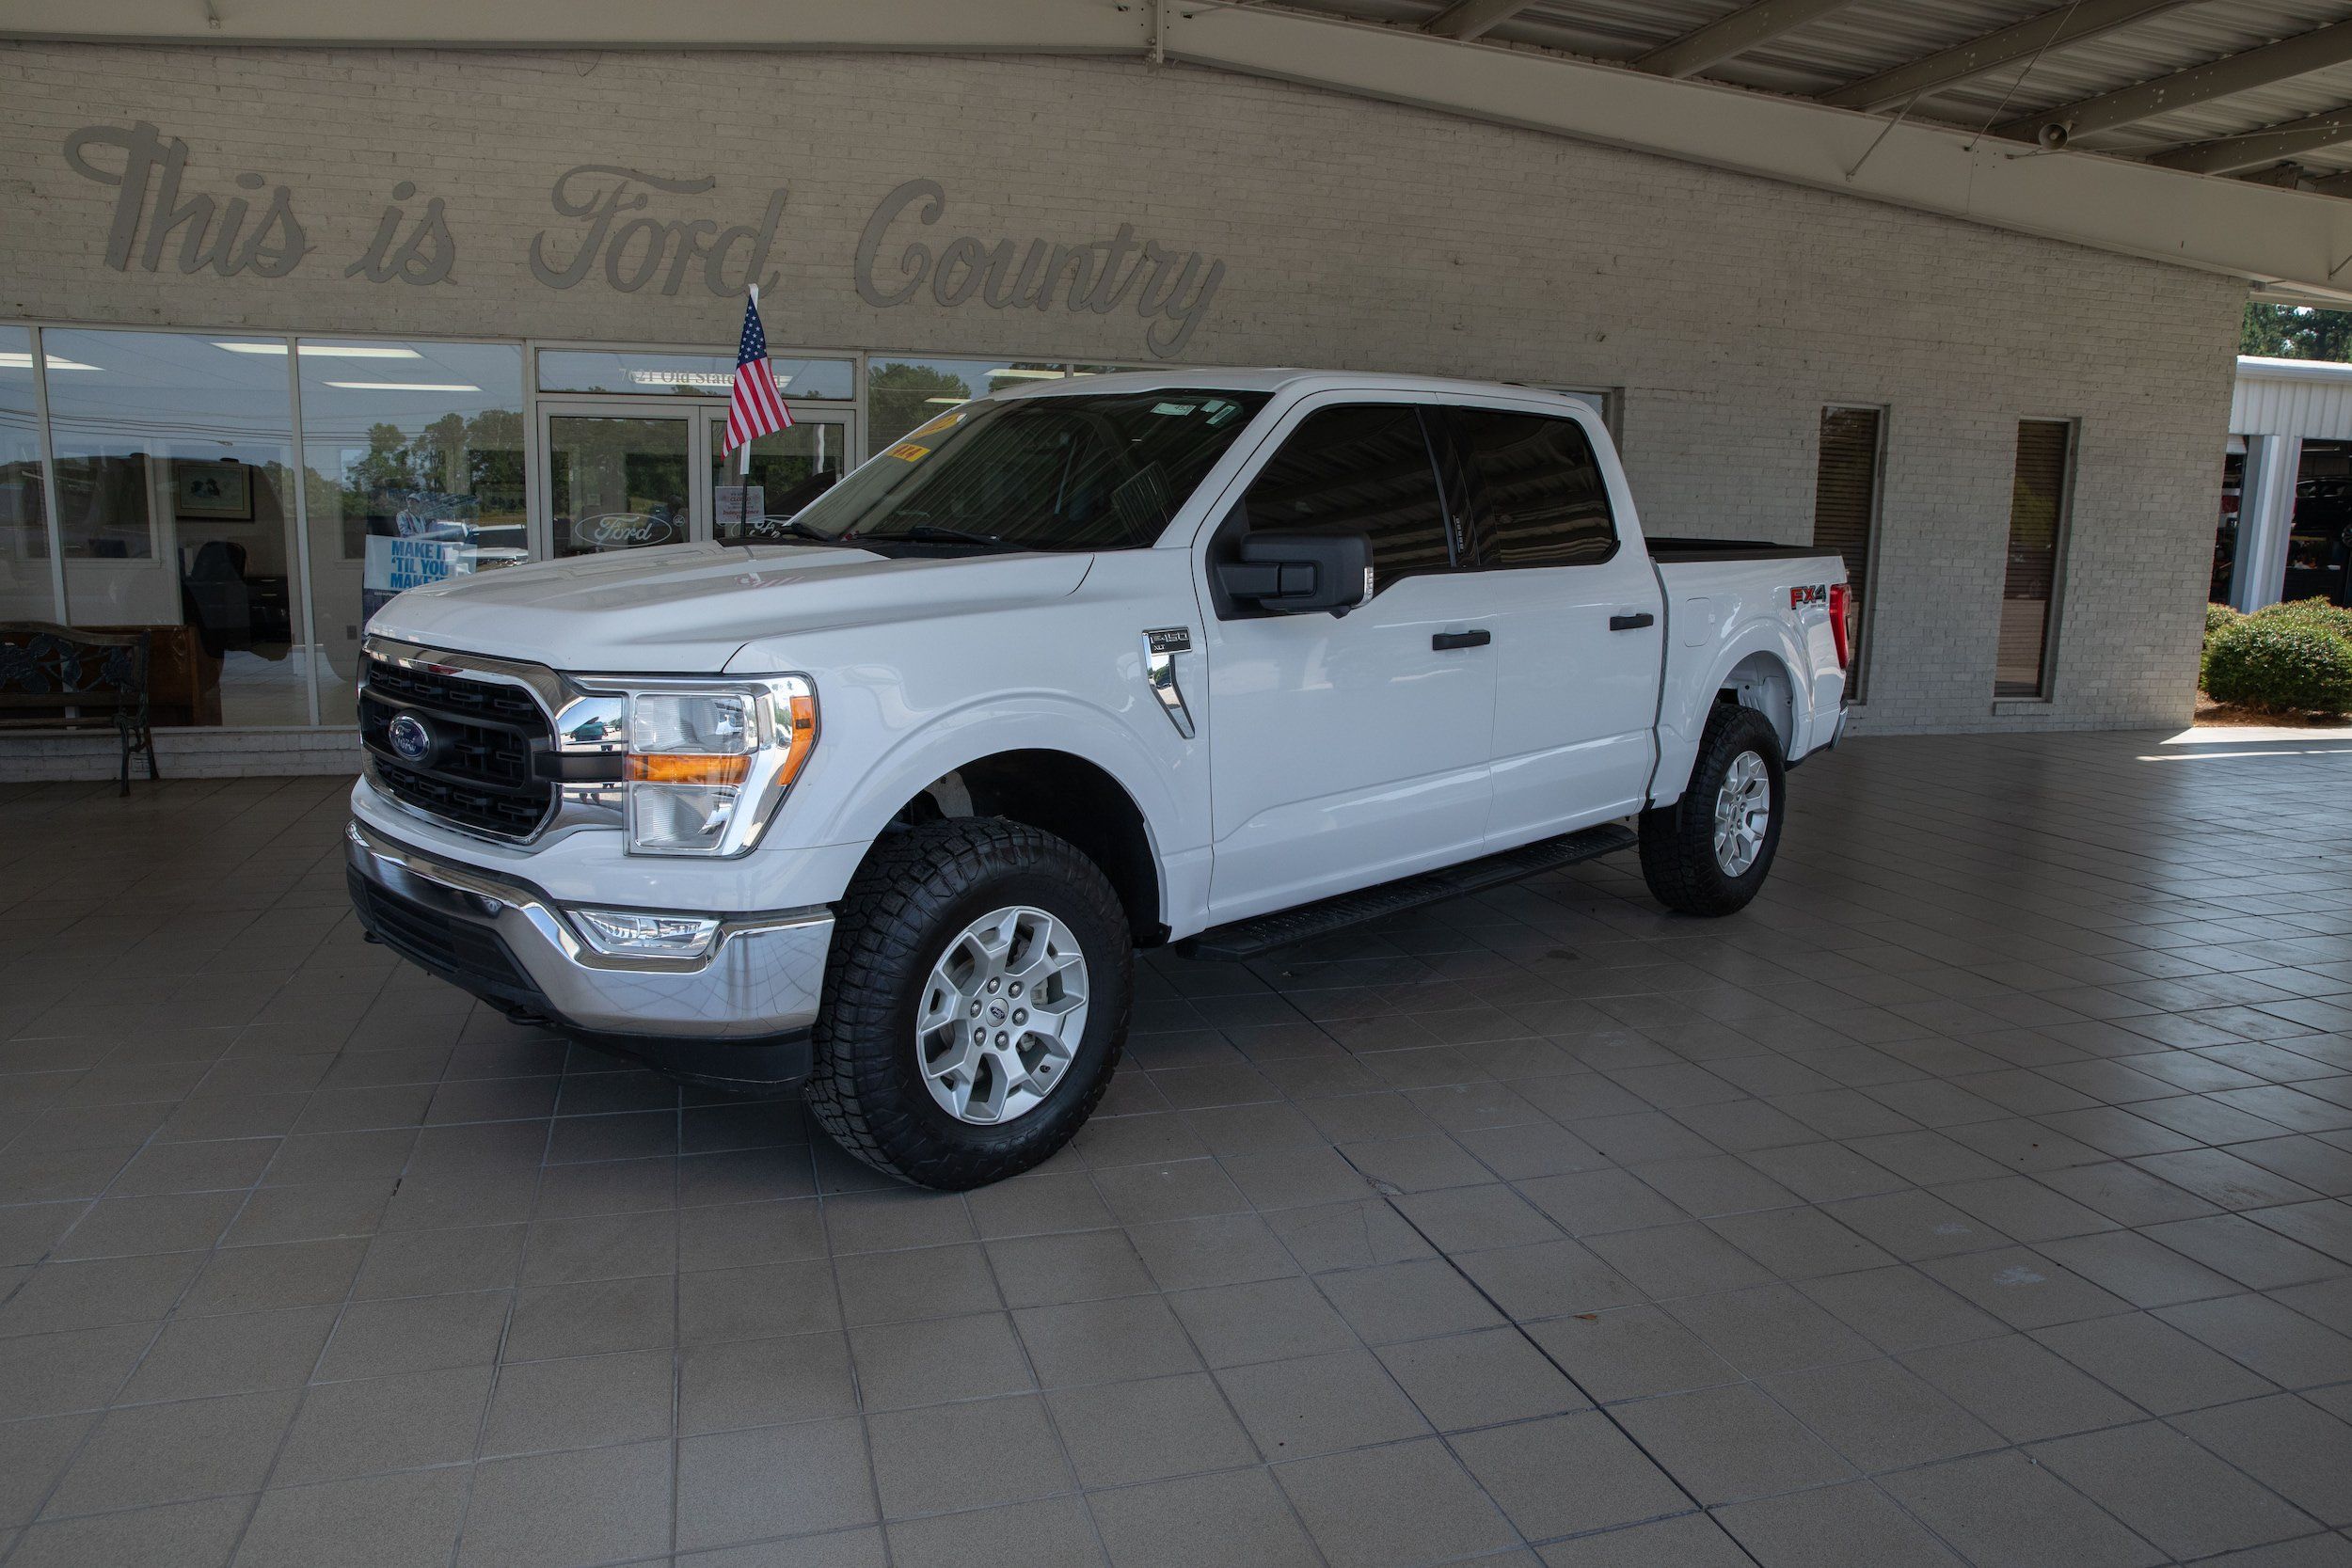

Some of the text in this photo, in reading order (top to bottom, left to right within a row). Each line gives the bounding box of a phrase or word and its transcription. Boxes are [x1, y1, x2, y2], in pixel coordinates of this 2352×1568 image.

[63, 119, 1223, 358] This is Ford Country
[661, 369, 691, 384] Old
[595, 516, 653, 541] Ford
[391, 540, 433, 560] MAKE
[421, 559, 450, 577] YOU
[1790, 584, 1827, 610] FX4
[1150, 632, 1189, 644] F-150
[394, 724, 418, 752] Ford
